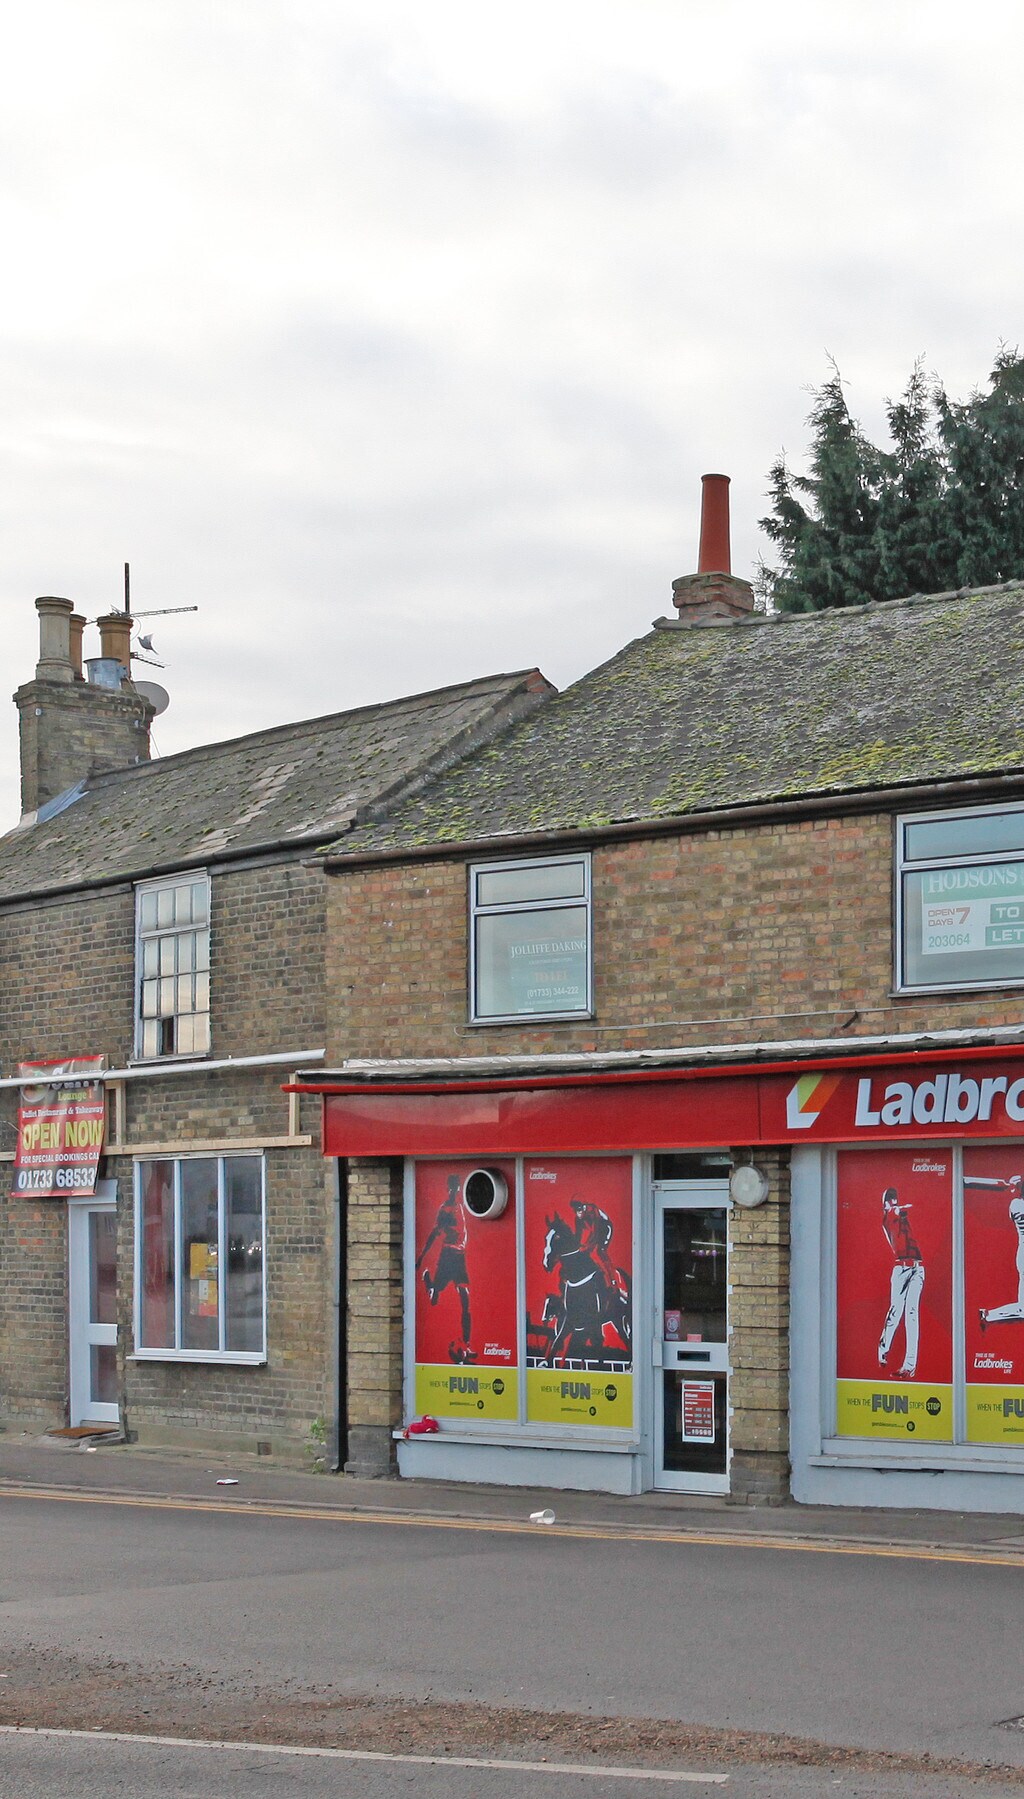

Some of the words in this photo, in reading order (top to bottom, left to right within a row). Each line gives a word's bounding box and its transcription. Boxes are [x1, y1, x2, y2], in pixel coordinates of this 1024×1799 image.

[927, 866, 1017, 893] HODSONS
[928, 908, 956, 918] OPEN
[956, 907, 971, 925] 7
[996, 906, 1020, 919] TO
[928, 918, 954, 927] DAYS
[928, 933, 971, 948] 203064
[992, 929, 1024, 941] LET
[511, 943, 551, 958] JOLLIFFE
[57, 1091, 87, 1101] Lounge
[23, 1122, 60, 1151] OPEN
[65, 1120, 104, 1147] NOW
[21, 1155, 31, 1164] FOR
[32, 1154, 54, 1163] SPECIAL
[55, 1152, 88, 1162] BOOKINGS
[18, 1169, 53, 1189] 01733
[56, 1168, 97, 1187] 68533
[974, 1358, 1013, 1369] Ladbrokes
[449, 1376, 478, 1394] FUN
[561, 1381, 591, 1400] FUN
[606, 1388, 617, 1396] STOP
[847, 1398, 861, 1406] WHEN
[872, 1394, 908, 1414] FUN
[909, 1401, 924, 1409] STOPS
[927, 1402, 940, 1410] STOP
[977, 1403, 991, 1411] WHEN
